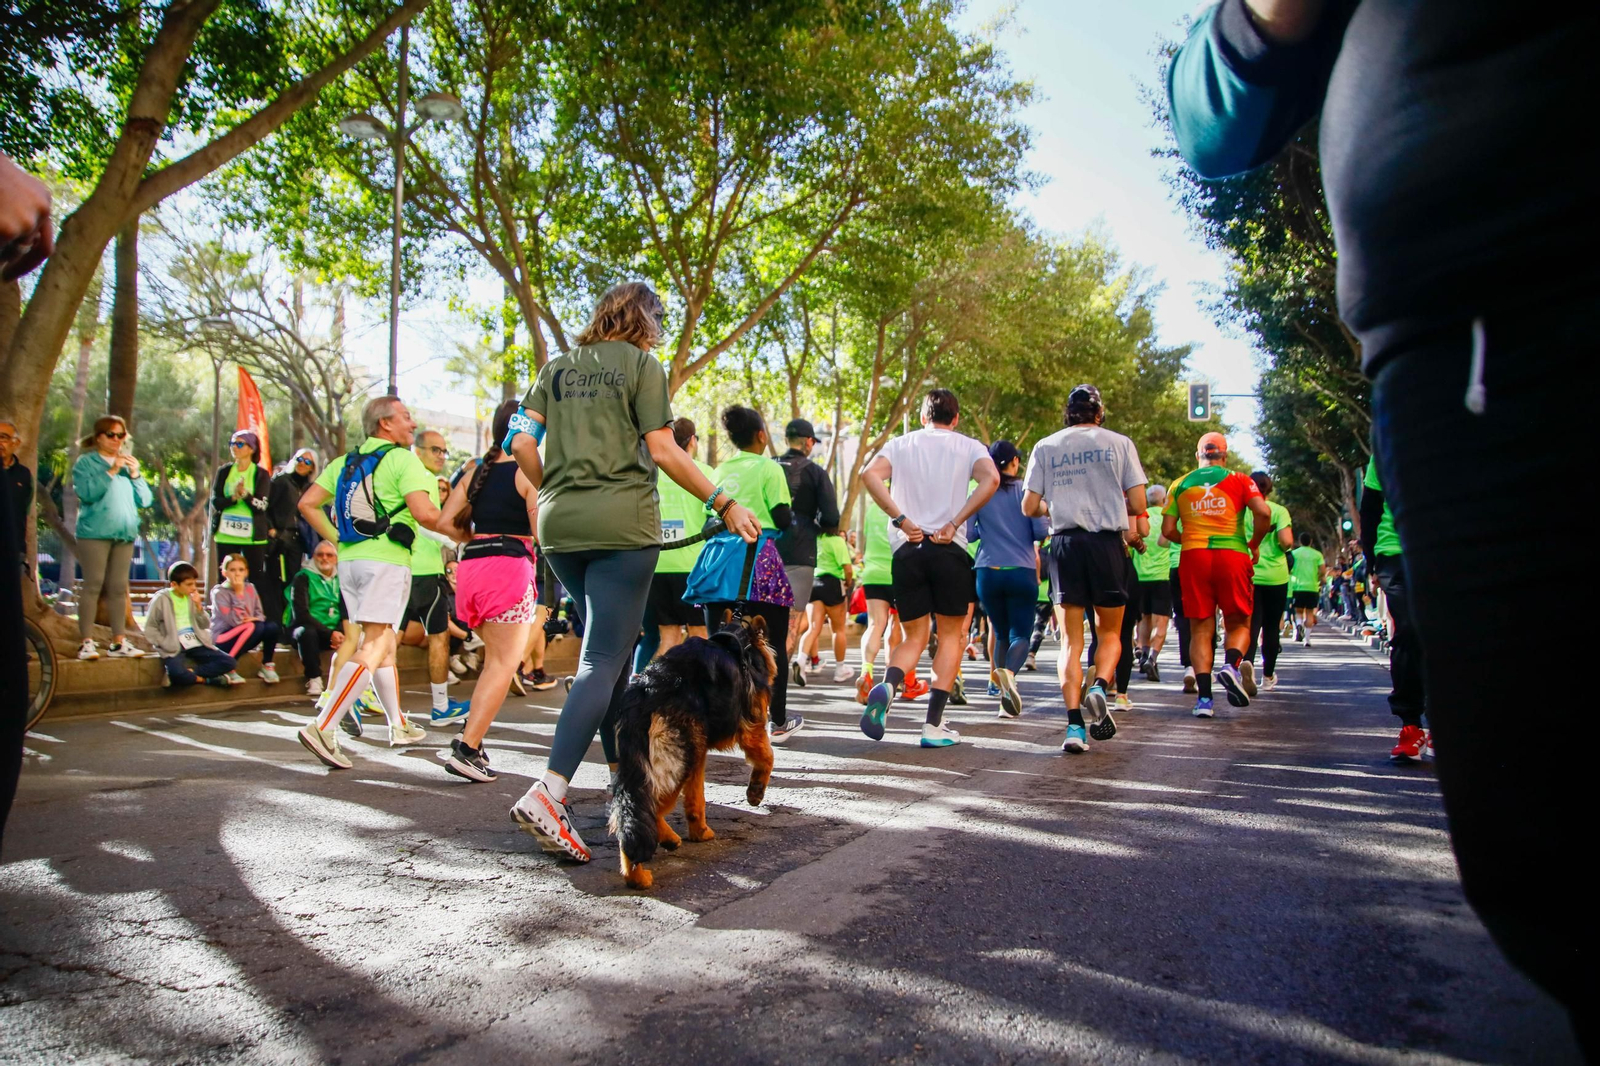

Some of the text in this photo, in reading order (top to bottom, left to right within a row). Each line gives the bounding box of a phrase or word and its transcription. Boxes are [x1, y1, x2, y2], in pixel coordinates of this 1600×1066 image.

[565, 367, 626, 387] Carrida
[1051, 447, 1114, 469] LAHRTÉ
[1053, 468, 1087, 478] TRAINING
[1052, 479, 1073, 487] CLUB
[226, 521, 249, 530] 1492
[661, 529, 677, 539] 61
